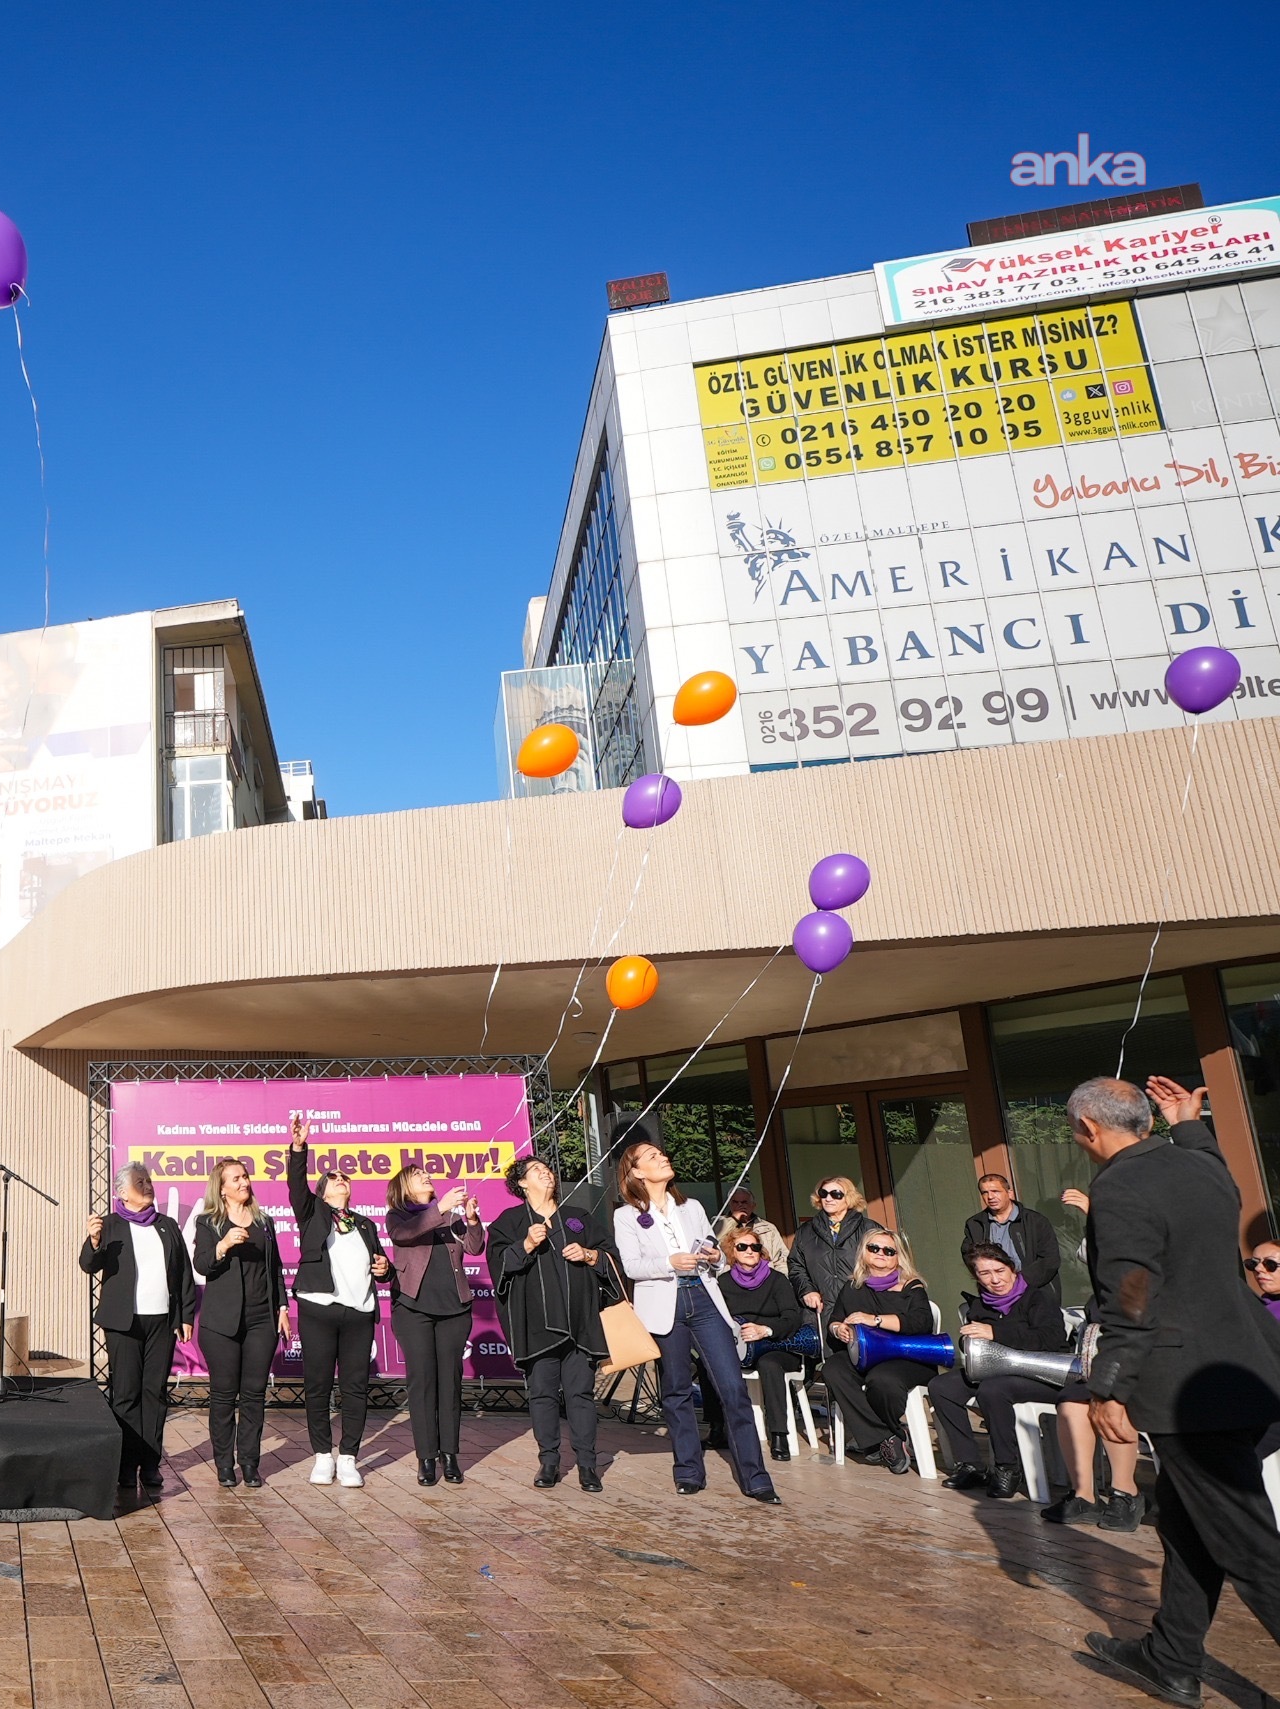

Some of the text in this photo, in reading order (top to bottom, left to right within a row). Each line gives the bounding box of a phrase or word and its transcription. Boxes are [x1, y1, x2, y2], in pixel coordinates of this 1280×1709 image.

[912, 231, 1271, 298] SINAV HAZIRLIK KURSLARI
[975, 223, 1223, 273] Yüksek Kariyer
[914, 296, 955, 309] 216
[963, 288, 1005, 302] 383
[1013, 282, 1041, 293] 77
[1050, 276, 1078, 287] 03
[1102, 266, 1146, 279] 530
[1155, 256, 1200, 271] 645
[1208, 249, 1239, 261] 46
[1247, 243, 1275, 255] 41
[922, 285, 1086, 316] www.yuksekkariyer.com.tr
[1098, 256, 1268, 289] info@yuksekkariyer.com.tr
[707, 313, 1119, 395] ÖZEL GÜVENLİK OLMAK İSTER MİSİNİZ?
[740, 348, 1088, 419] GÜVENLİK KURSU
[781, 393, 1036, 444] 0216 450 20 20
[1062, 400, 1153, 427] 3gguvenlik
[1068, 418, 1158, 438] www.3gguvenlik.com
[784, 419, 1043, 470] 0554 857 10 95
[1033, 452, 1280, 509] Yabancı Dil, Bi
[819, 520, 951, 544] ÖZEL MALTEPE
[779, 533, 1191, 606] AMERİKAN
[739, 588, 1280, 676] YABANCI Dİ
[758, 710, 777, 744] 0216
[777, 702, 880, 742] 352
[900, 695, 967, 733] 92
[981, 687, 1050, 726] 99
[24, 836, 70, 848] Maltepe
[157, 1124, 196, 1136] Kadına
[198, 1122, 241, 1135] Yönelik
[243, 1122, 288, 1136] Şiddete
[322, 1122, 390, 1133] Uluslararası
[392, 1120, 448, 1132] Mücadele
[450, 1119, 481, 1132] Günü
[306, 1109, 341, 1120] Kasım
[478, 1342, 511, 1356] SED
